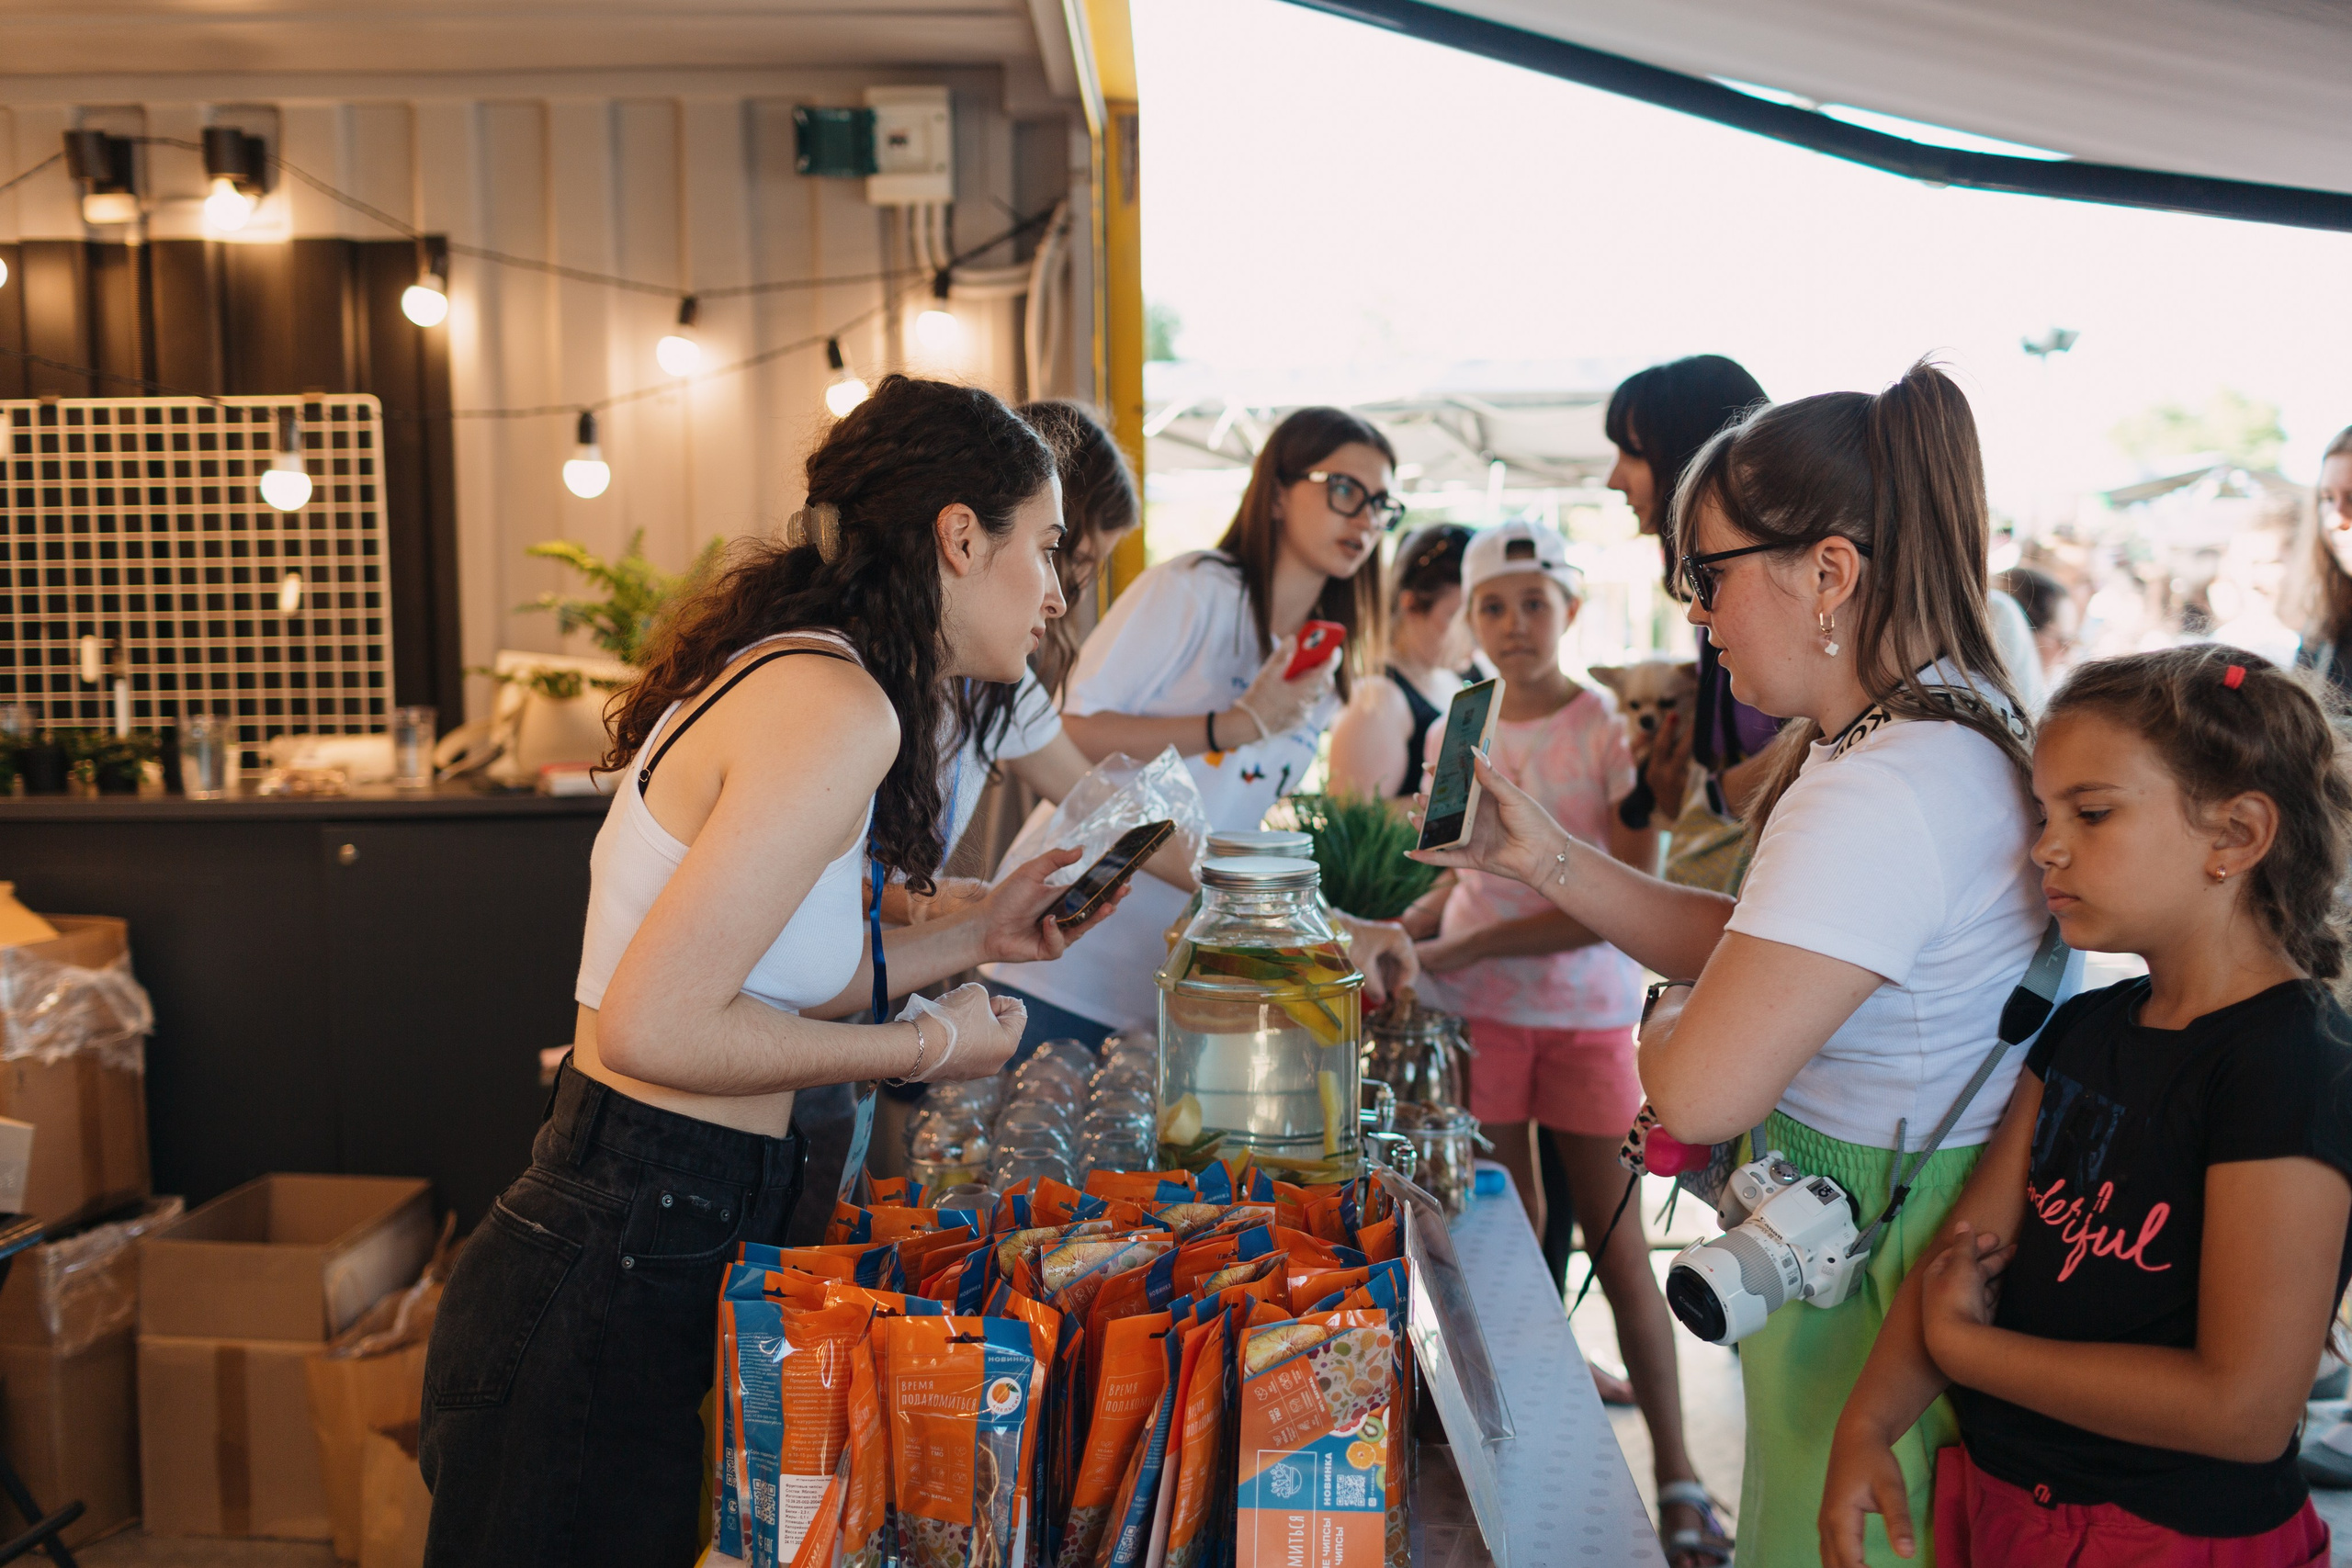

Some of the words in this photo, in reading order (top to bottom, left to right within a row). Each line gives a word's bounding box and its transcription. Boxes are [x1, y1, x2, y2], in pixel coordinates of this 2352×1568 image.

[1760, 1216, 1783, 1240] Canon
[958, 1283, 982, 1298] НОВИНКА
[1149, 1283, 1172, 1298] НОВИНКА
[901, 1380, 934, 1392] ВРЕМЯ
[1108, 1382, 1138, 1396] ВРЕМЯ
[901, 1393, 978, 1412] ПОЛАКОМИТЬСЯ
[992, 1395, 1020, 1413] АПЕЛЬСИН
[1105, 1396, 1156, 1413] ПОЛАКОМИ
[1323, 1452, 1333, 1506] НОВИНКА
[931, 1494, 953, 1503] NATURAL
[1288, 1515, 1305, 1567] МИТЬСЯ
[1322, 1517, 1331, 1556] ЧИПСЫ
[1335, 1527, 1344, 1566] ЧИПСЫ
